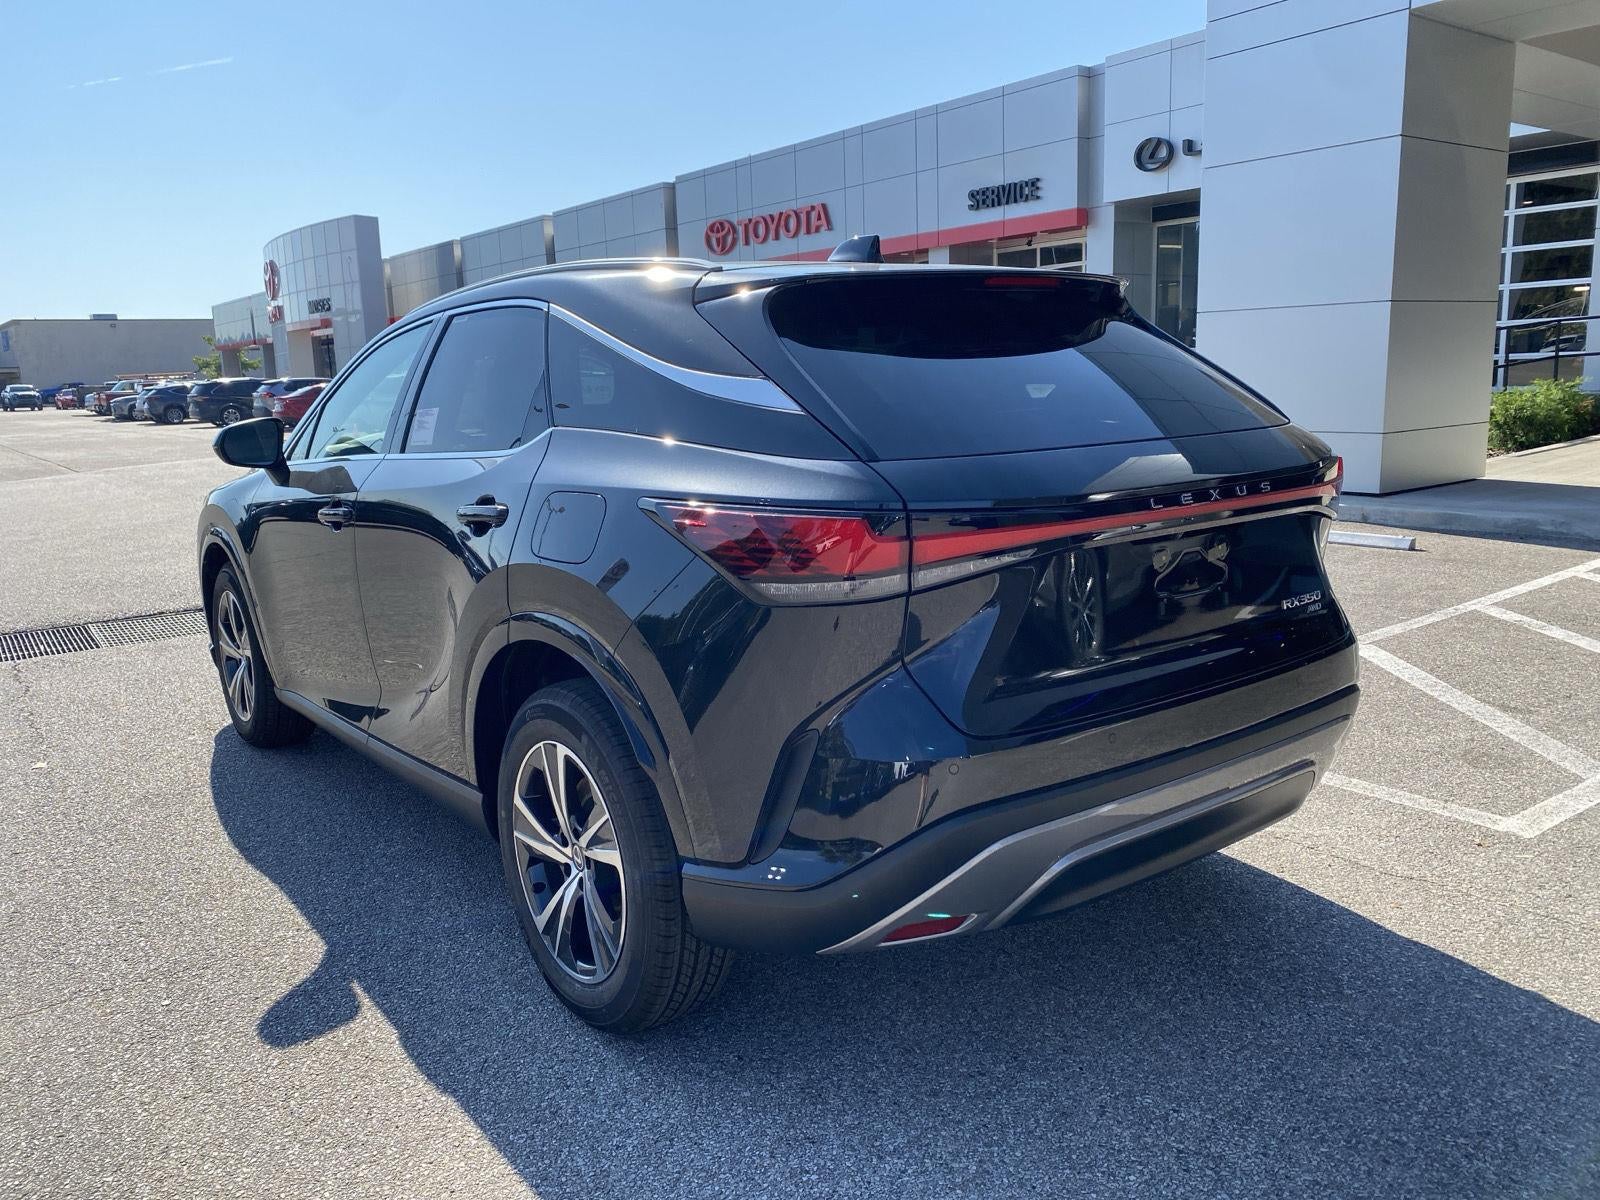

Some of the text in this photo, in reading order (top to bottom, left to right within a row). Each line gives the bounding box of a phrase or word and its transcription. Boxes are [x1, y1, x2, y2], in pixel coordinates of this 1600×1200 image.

[968, 177, 1043, 211] SERVICE
[736, 202, 833, 246] TOYOTA
[1150, 481, 1271, 509] LEXUS
[1306, 602, 1322, 614] AWD
